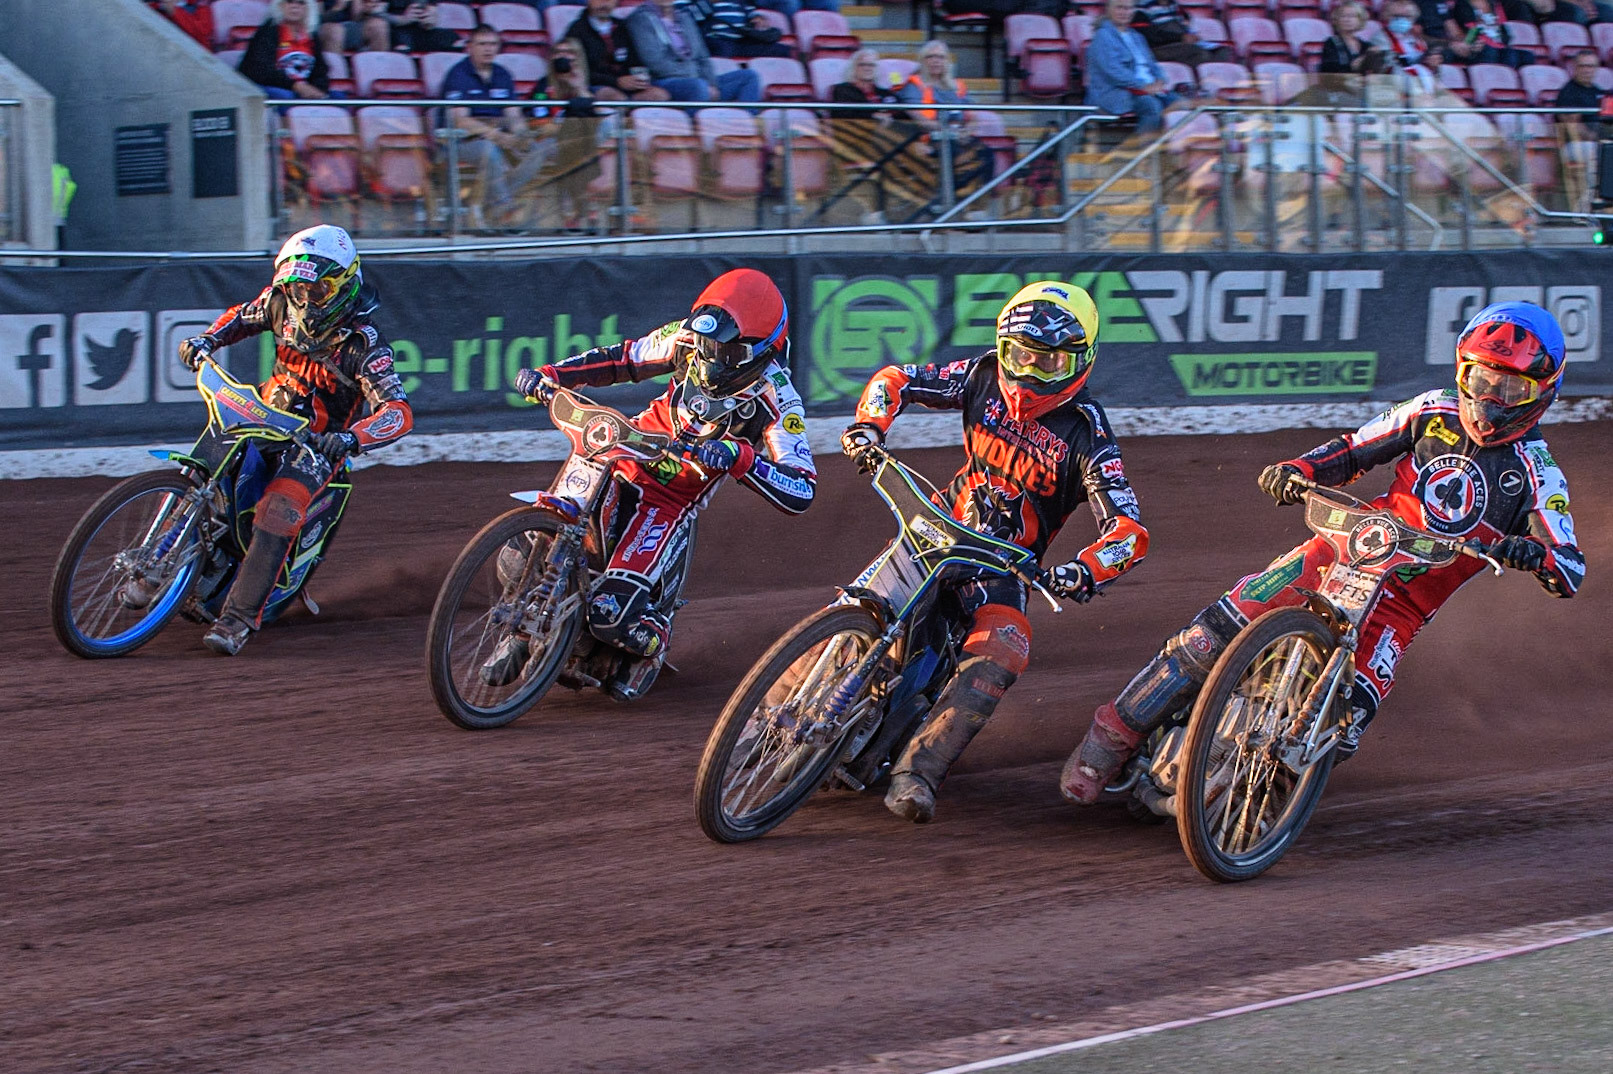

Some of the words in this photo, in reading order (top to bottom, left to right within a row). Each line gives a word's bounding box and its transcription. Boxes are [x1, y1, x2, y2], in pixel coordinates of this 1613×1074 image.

[951, 270, 1383, 346] BERIGHT
[1192, 359, 1370, 389] MOTORBIKE
[251, 406, 268, 418] LESS
[1001, 411, 1069, 463] PARRYS
[972, 423, 1057, 497] WOLVES
[1429, 458, 1457, 473] BELLE
[1459, 461, 1477, 480] VUE
[1473, 481, 1484, 509] ACES
[1250, 583, 1267, 597] SKIP
[1267, 572, 1284, 587] HIRE
[1340, 584, 1371, 602] FTS
